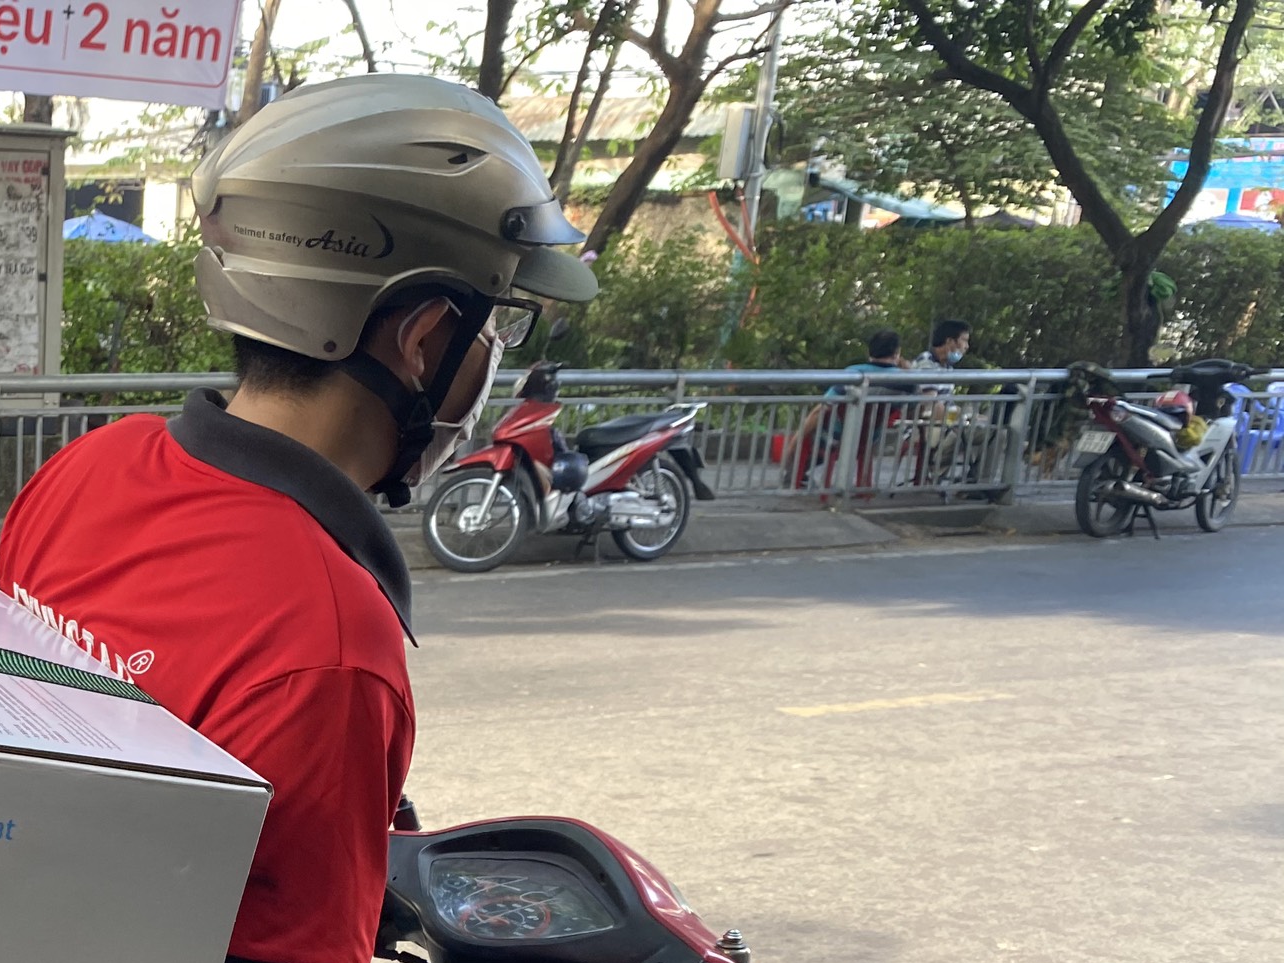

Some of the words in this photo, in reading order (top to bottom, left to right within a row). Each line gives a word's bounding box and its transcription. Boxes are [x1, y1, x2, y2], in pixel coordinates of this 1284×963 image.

[80, 2, 109, 50] 2
[123, 7, 222, 62] năm
[234, 224, 266, 238] helmet
[268, 232, 303, 247] safety
[306, 229, 369, 258] Asia
